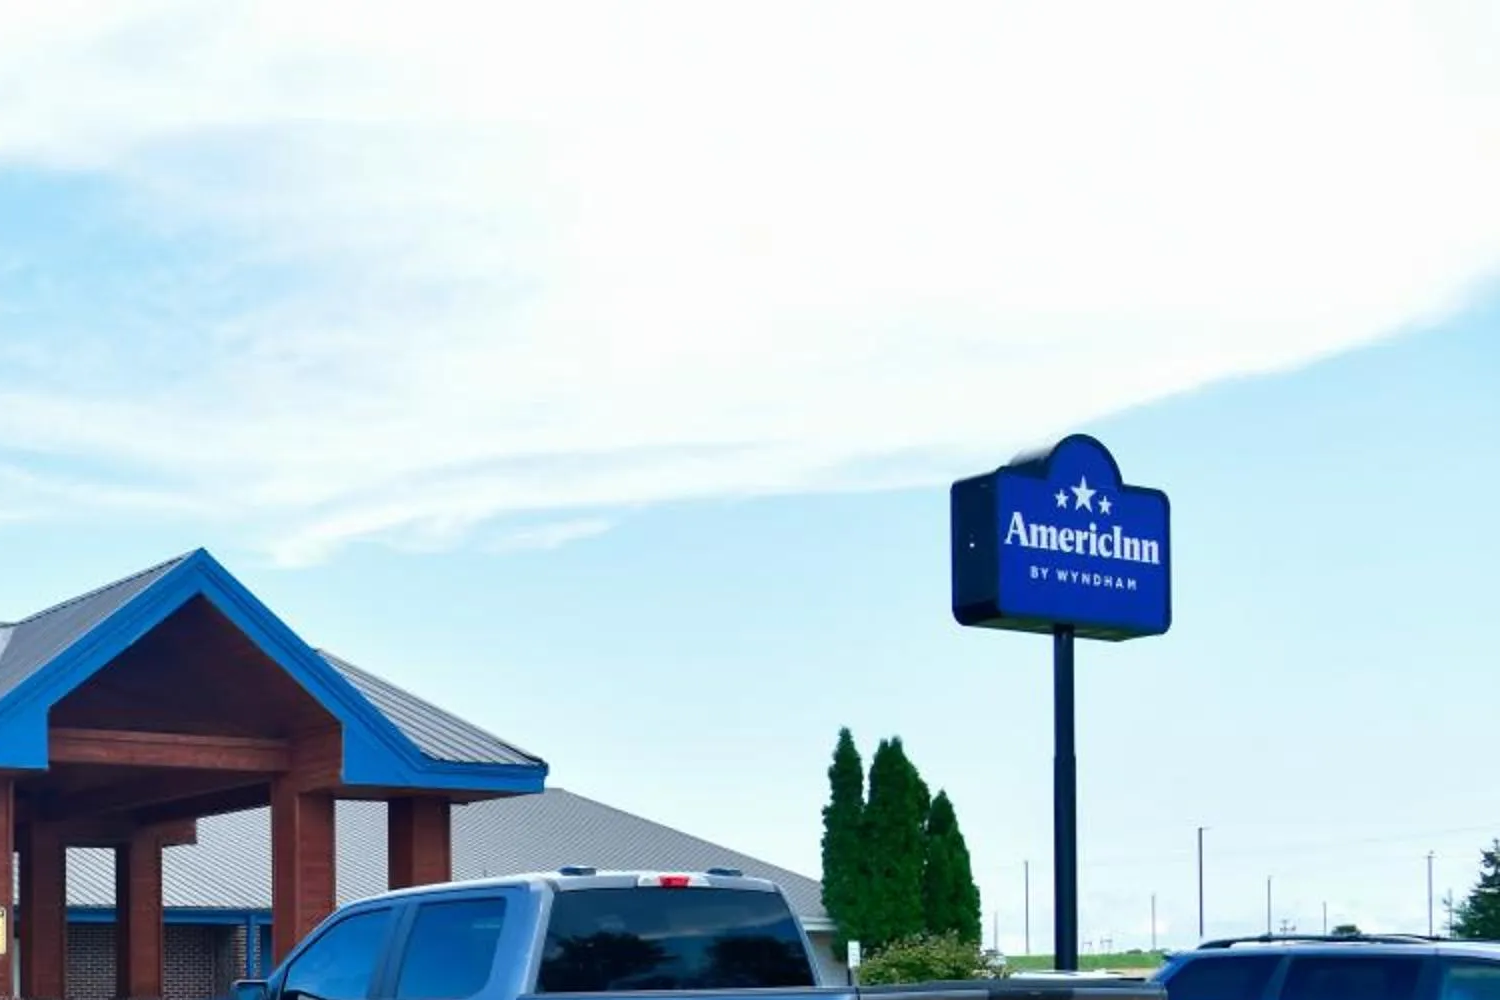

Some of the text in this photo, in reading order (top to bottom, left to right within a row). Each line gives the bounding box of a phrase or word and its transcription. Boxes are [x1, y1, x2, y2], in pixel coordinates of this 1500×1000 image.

[1004, 511, 1160, 565] AmericInn
[1030, 565, 1137, 591] BY WYNDHAM
